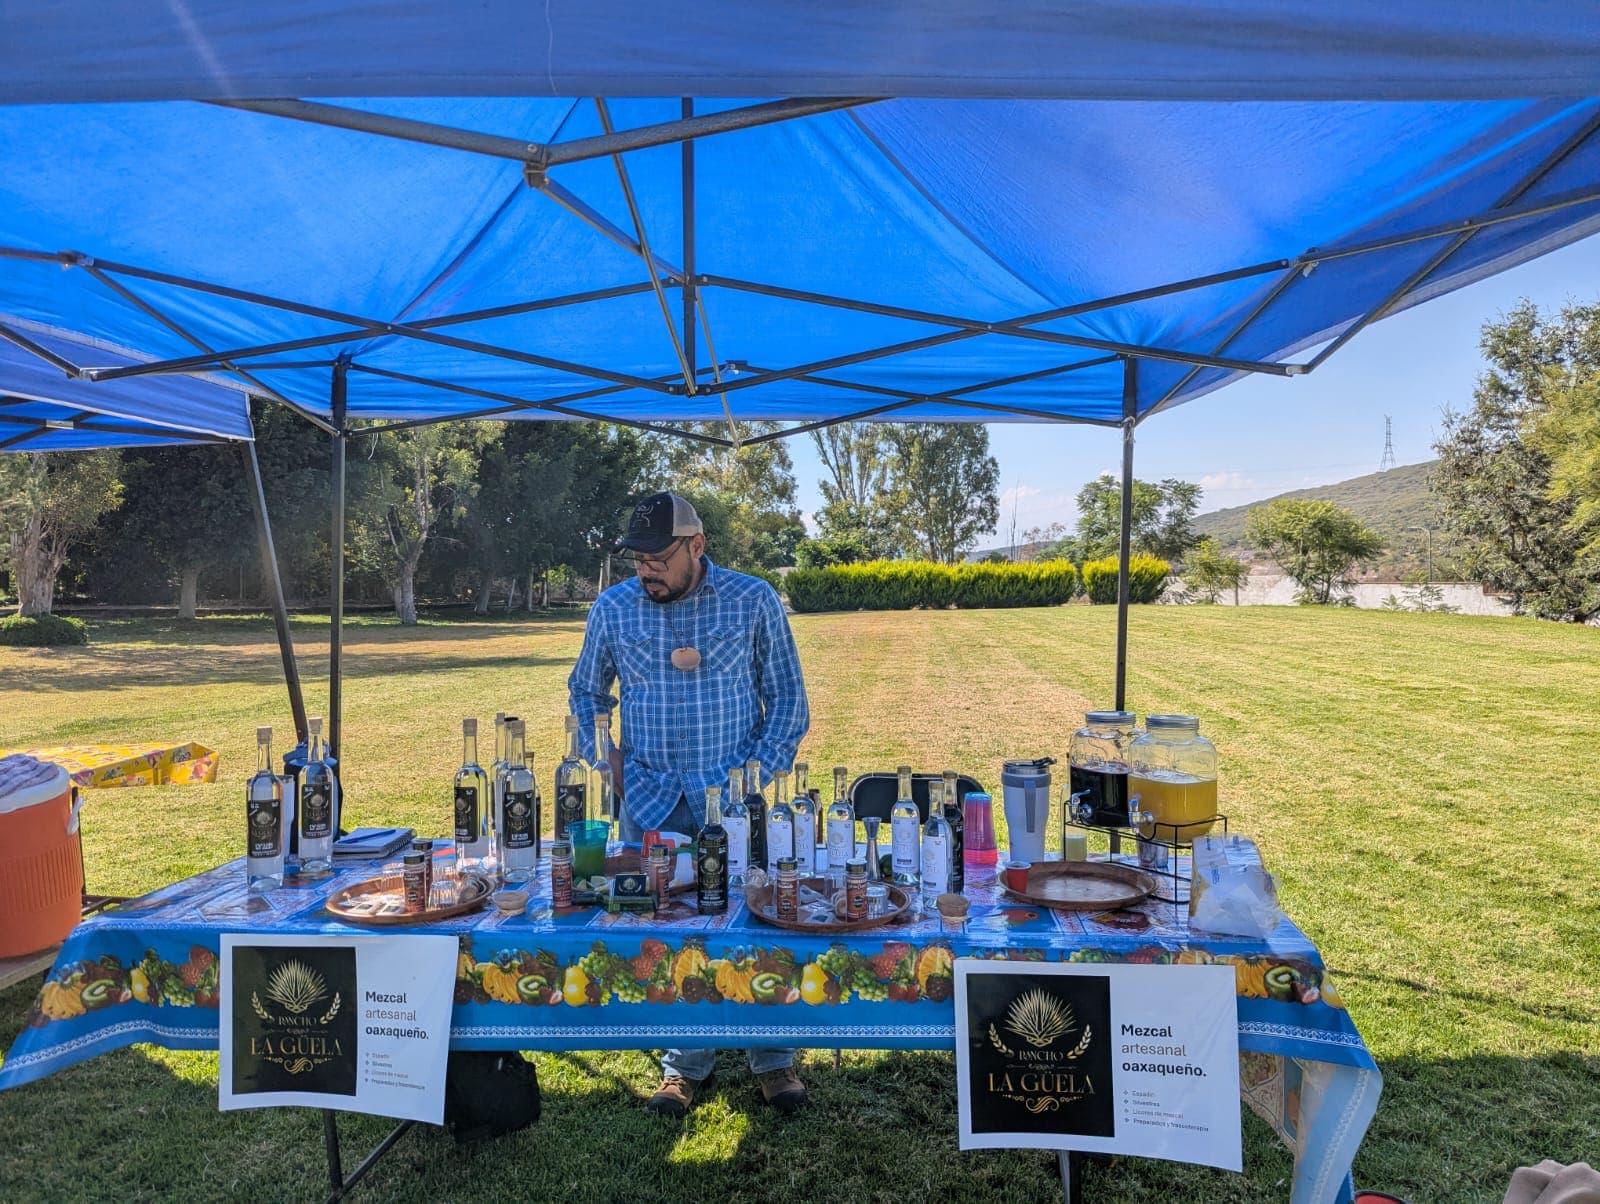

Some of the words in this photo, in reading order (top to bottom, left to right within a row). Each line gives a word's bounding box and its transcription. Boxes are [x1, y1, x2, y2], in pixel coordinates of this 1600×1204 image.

[365, 991, 407, 1004] Mezcal
[365, 1009, 416, 1022] artesanal
[365, 1026, 429, 1040] oaxaqueño.
[1121, 1024, 1173, 1038] Mezcal
[251, 1037, 274, 1056] LA
[280, 1035, 343, 1056] GÜELA
[1121, 1043, 1187, 1057] artesanal
[1122, 1062, 1208, 1078] oaxaqueño.
[989, 1072, 1014, 1092] LA
[1020, 1070, 1095, 1094] GÜELA
